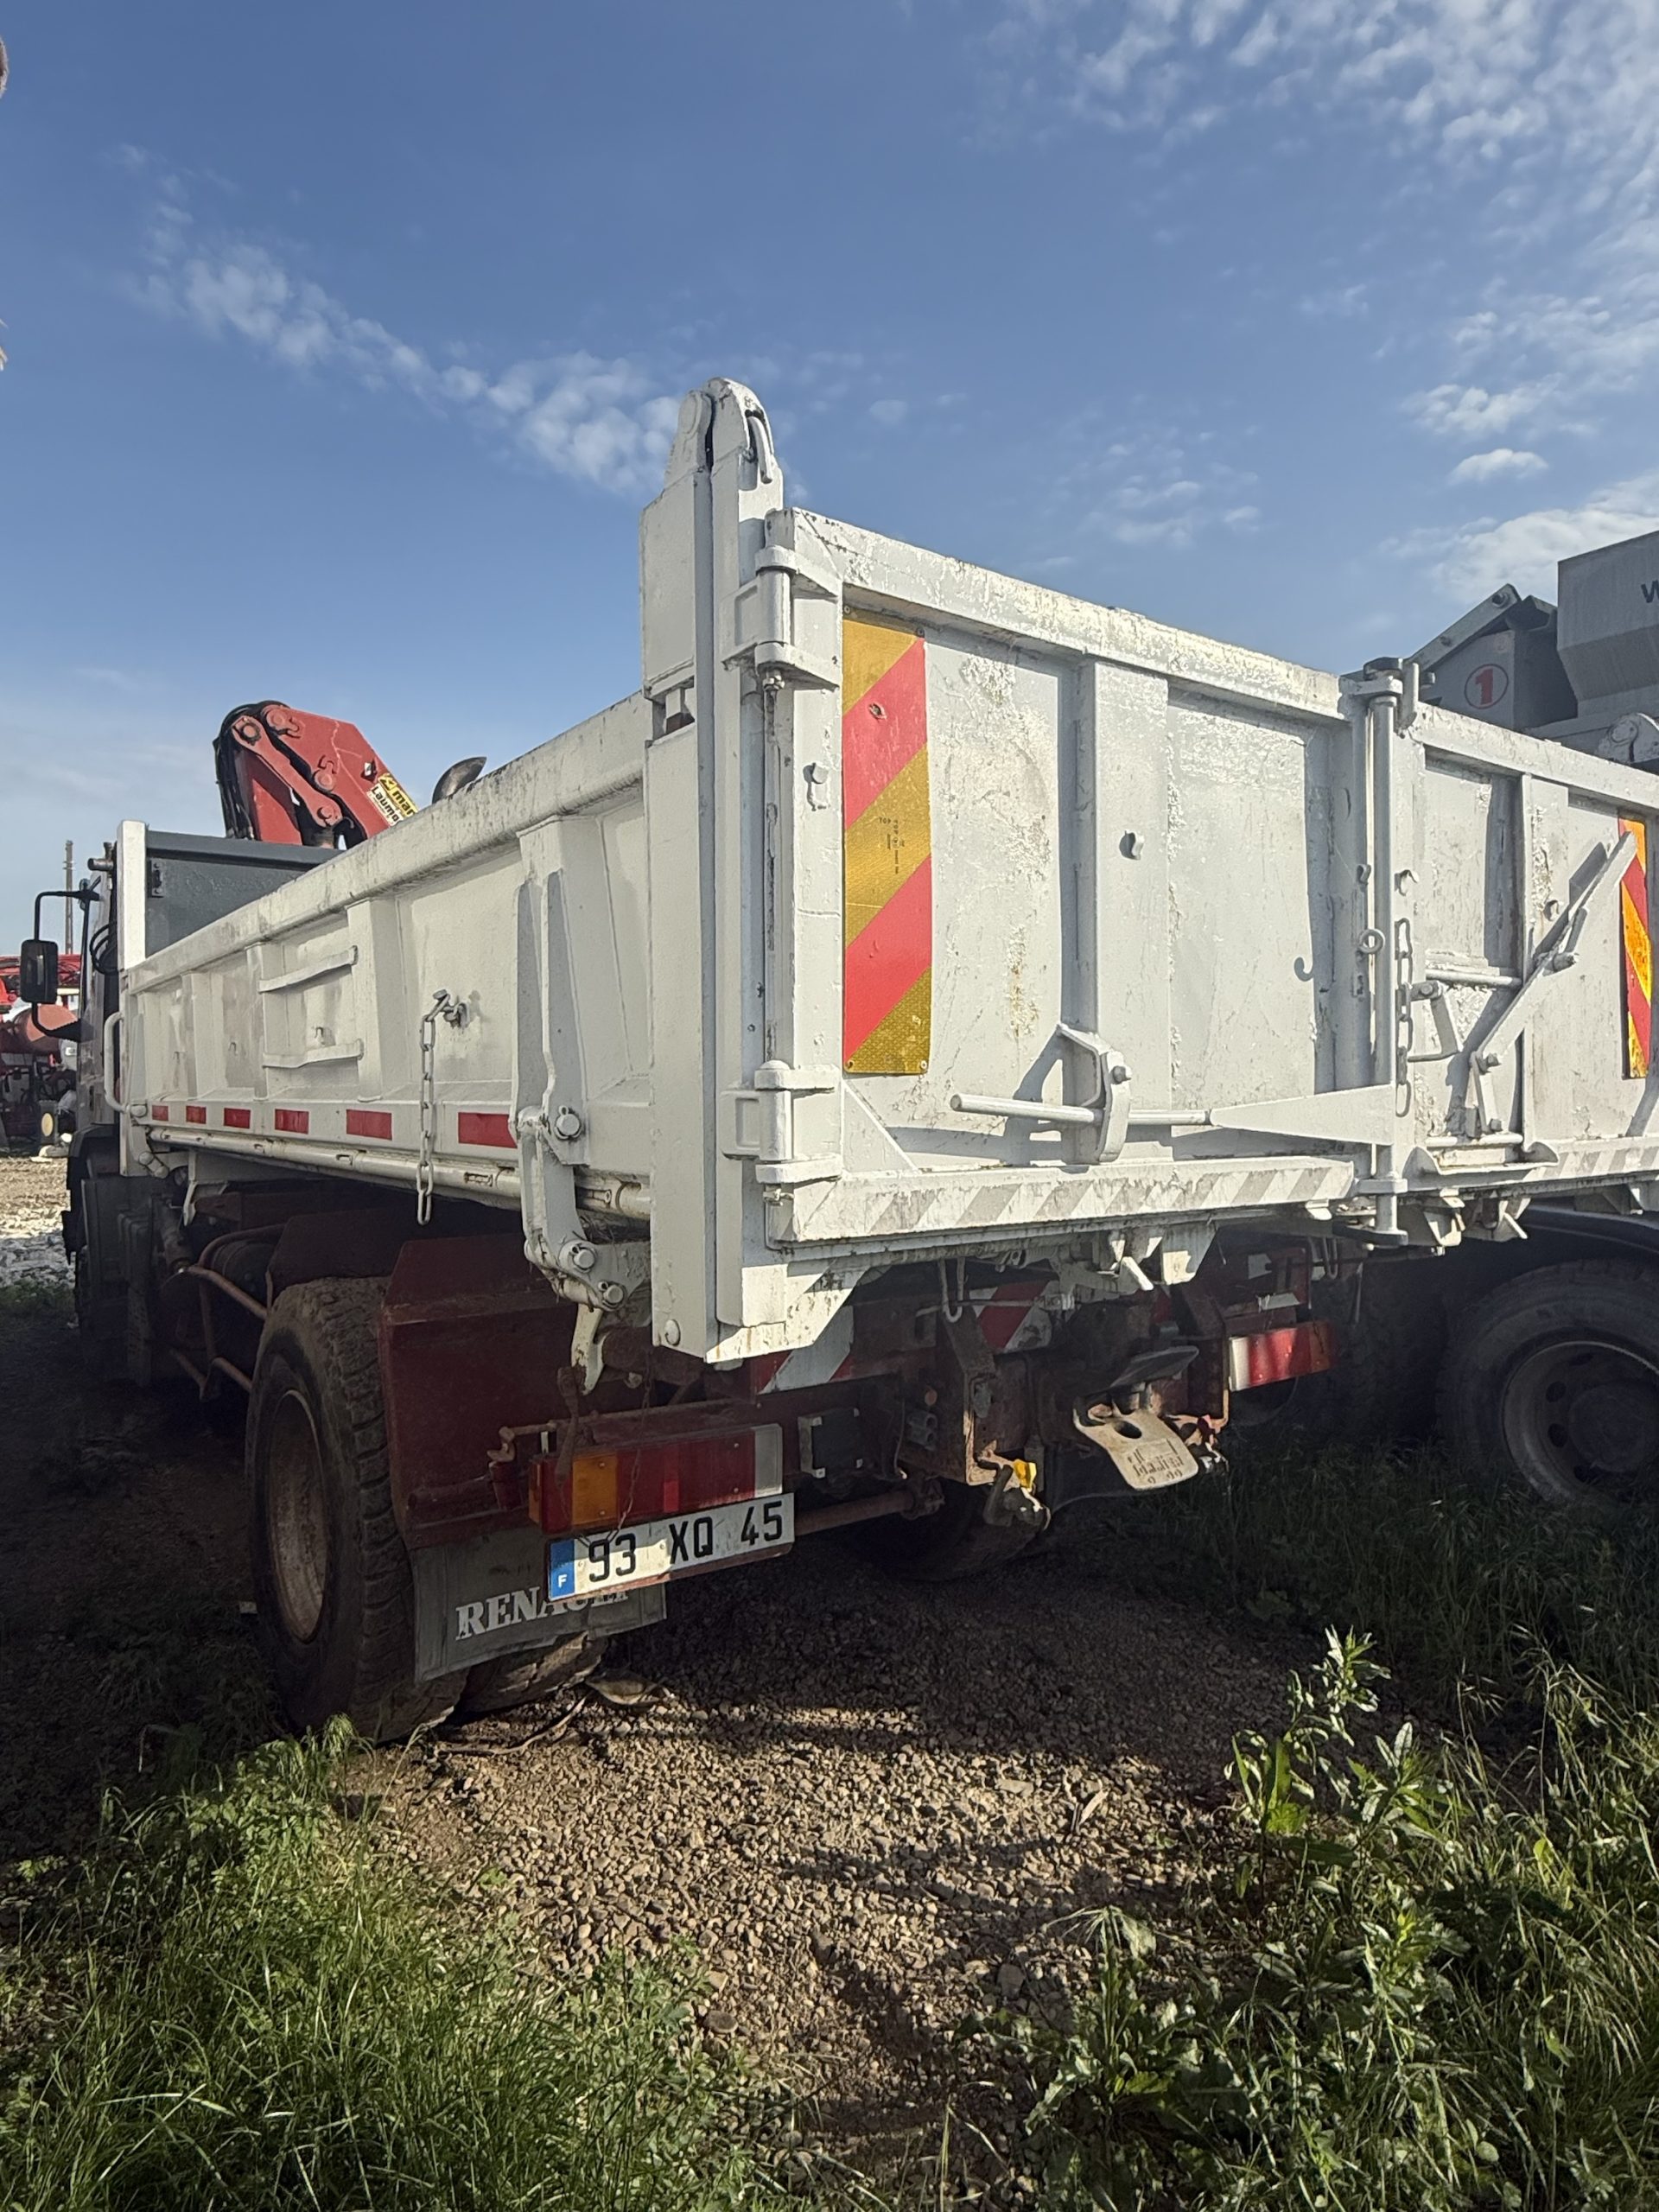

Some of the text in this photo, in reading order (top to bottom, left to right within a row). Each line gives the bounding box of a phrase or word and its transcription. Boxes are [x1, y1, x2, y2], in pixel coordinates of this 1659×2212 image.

[1475, 669, 1494, 706] 1
[557, 1501, 783, 1589] F 93 XQ 45
